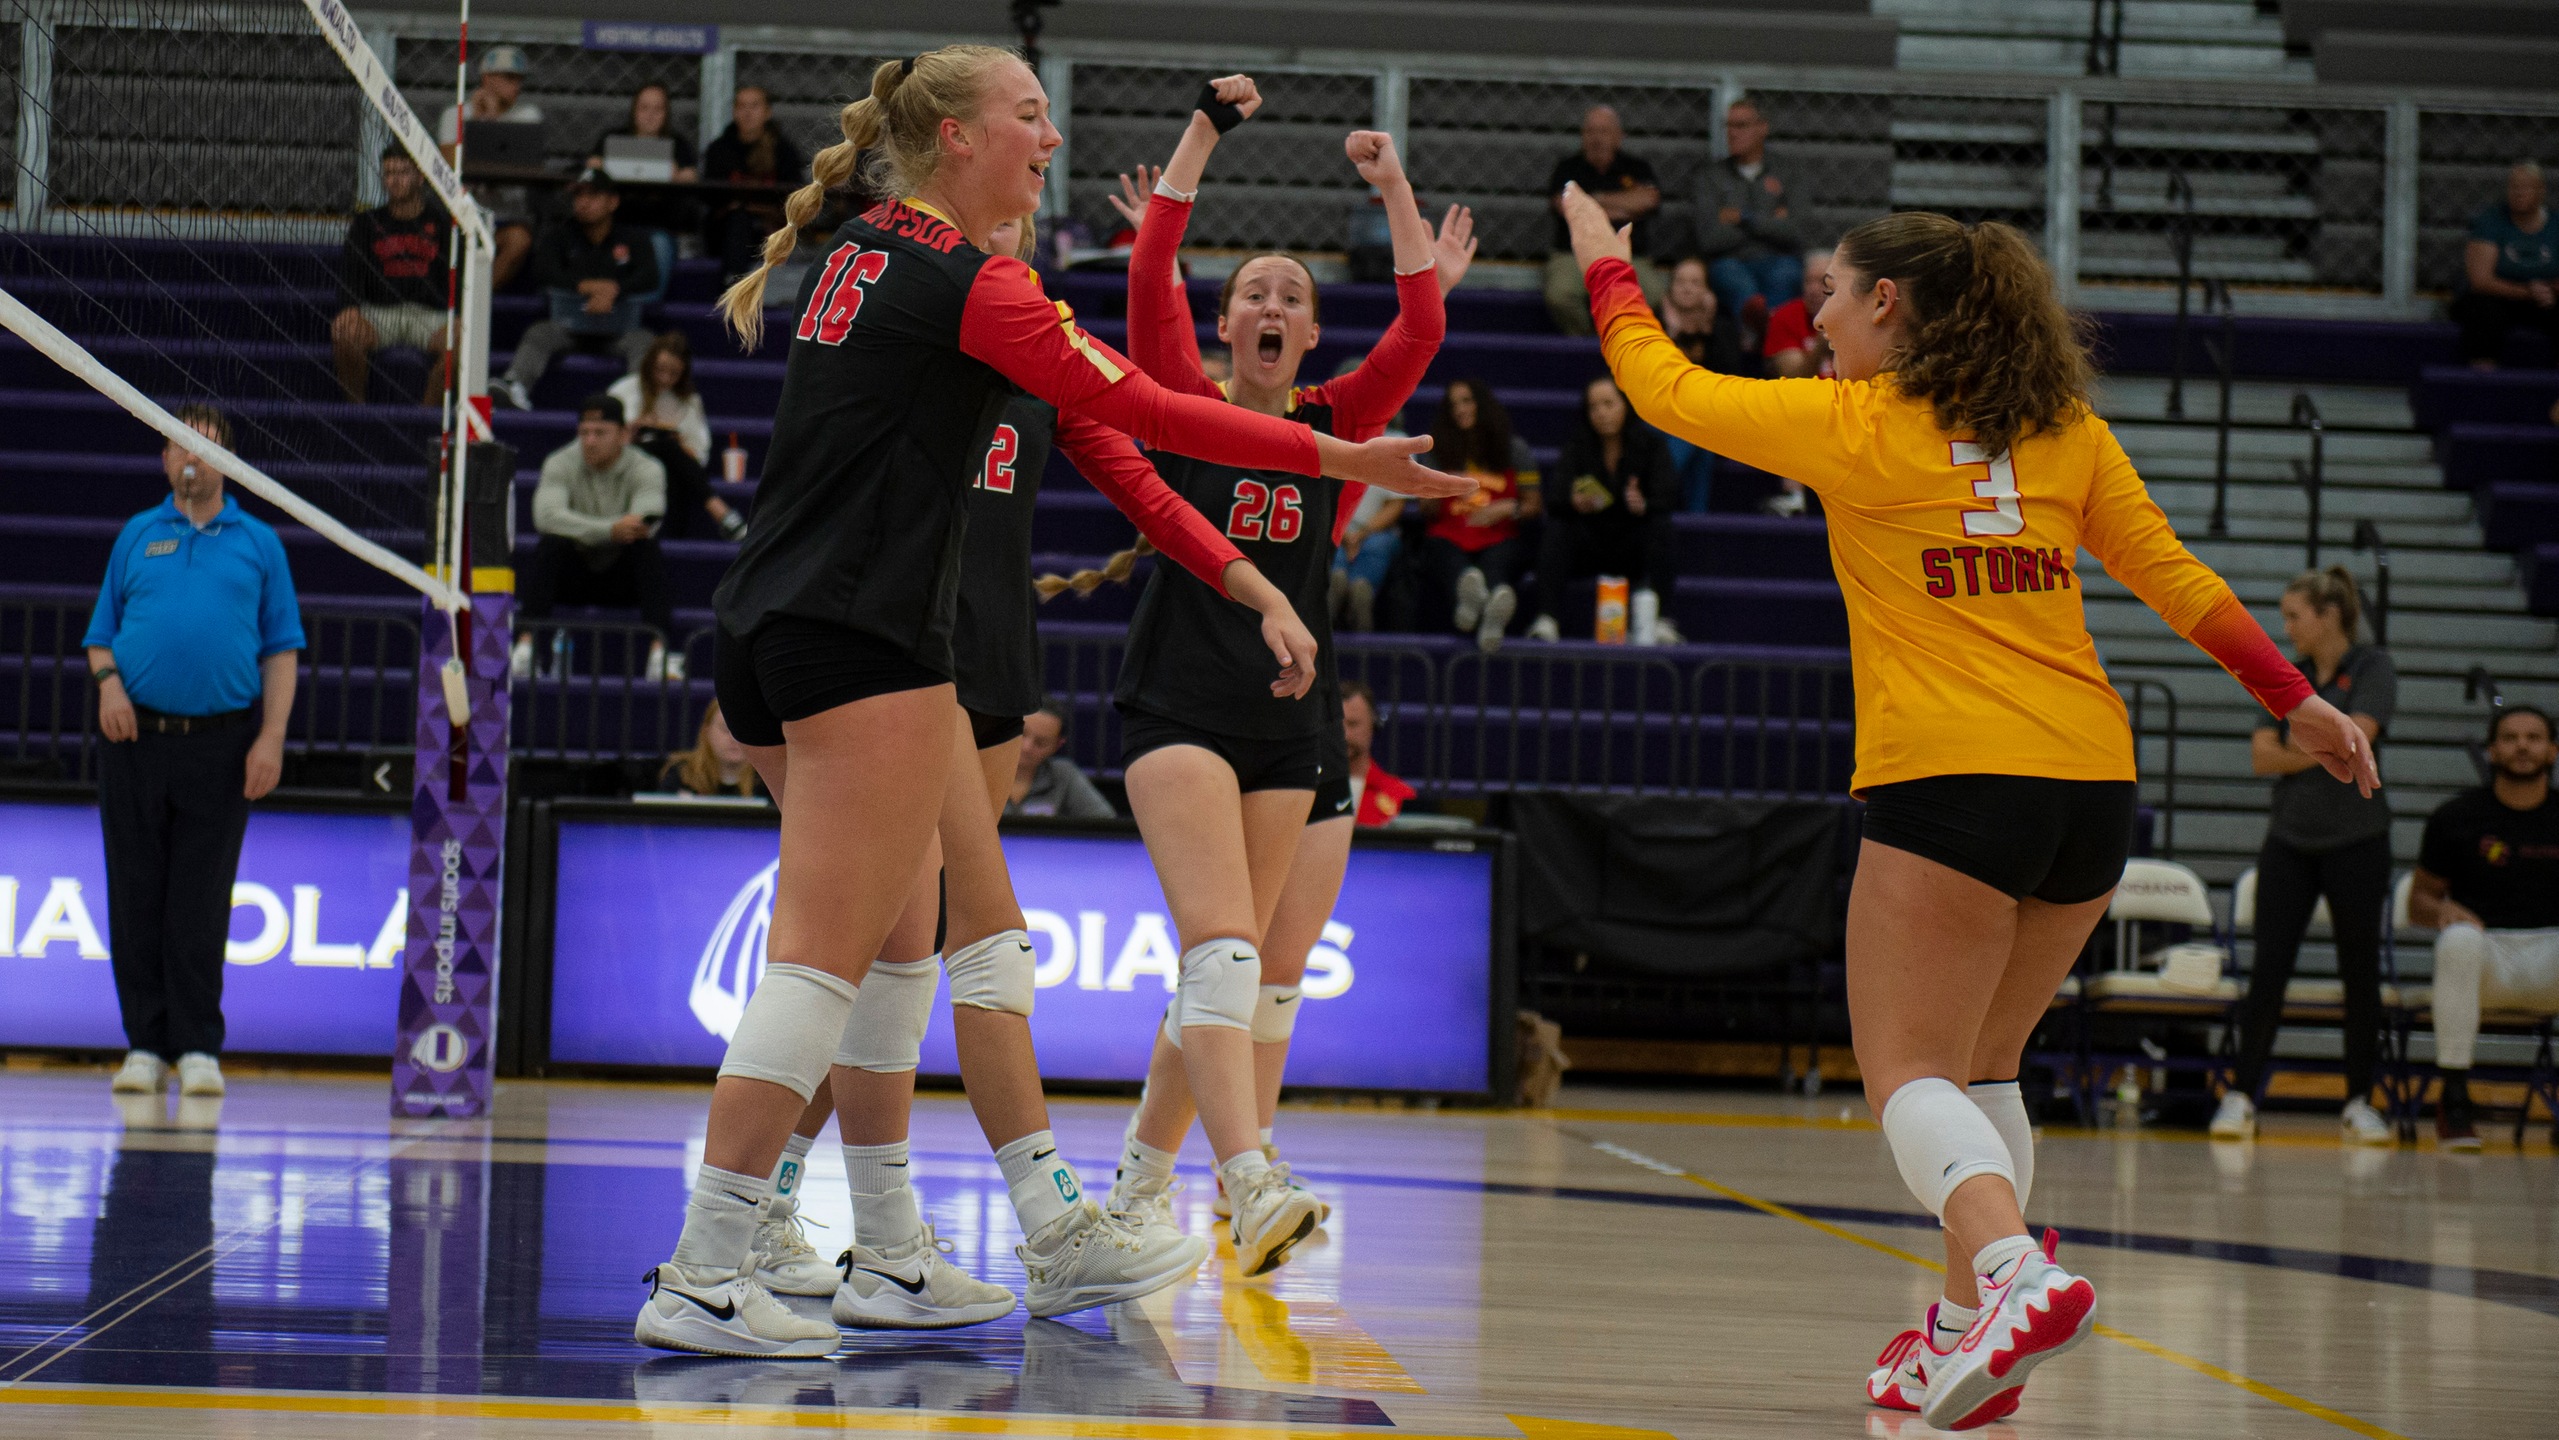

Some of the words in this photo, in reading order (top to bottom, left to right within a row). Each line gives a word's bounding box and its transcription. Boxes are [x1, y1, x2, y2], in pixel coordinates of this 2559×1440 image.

[796, 240, 889, 347] 16
[973, 423, 1020, 494] 2
[1949, 439, 2026, 538] 3
[1226, 478, 1304, 543] 26
[1921, 546, 2071, 598] STORM
[439, 838, 462, 912] sports
[433, 914, 459, 1005] imports
